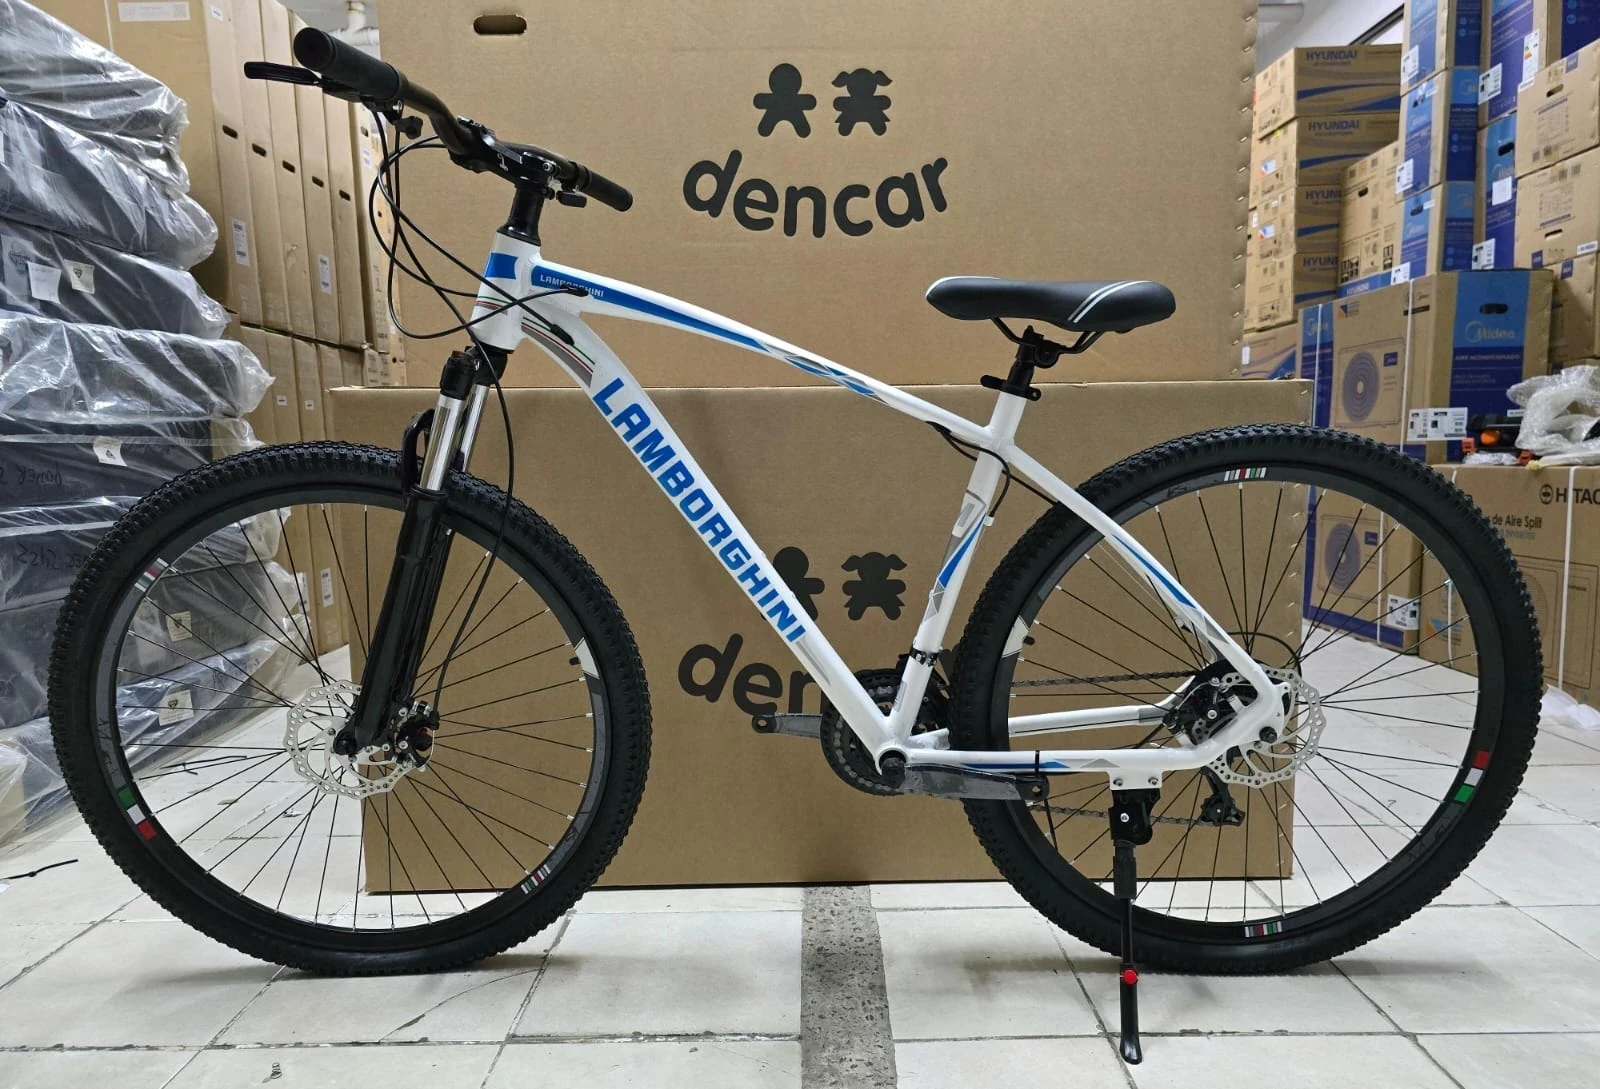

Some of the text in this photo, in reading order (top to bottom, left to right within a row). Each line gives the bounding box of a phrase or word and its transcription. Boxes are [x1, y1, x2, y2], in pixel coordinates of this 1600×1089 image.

[1306, 50, 1357, 61] HYUNDAI
[1308, 120, 1360, 131] HYUNDAI
[683, 150, 948, 238] dencar
[1306, 189, 1341, 199] HYUN
[1303, 256, 1338, 267] HYUN
[1556, 487, 1600, 505] HTAC
[593, 377, 806, 643] LAMBORGHINI
[1492, 513, 1543, 530] de Aire Split
